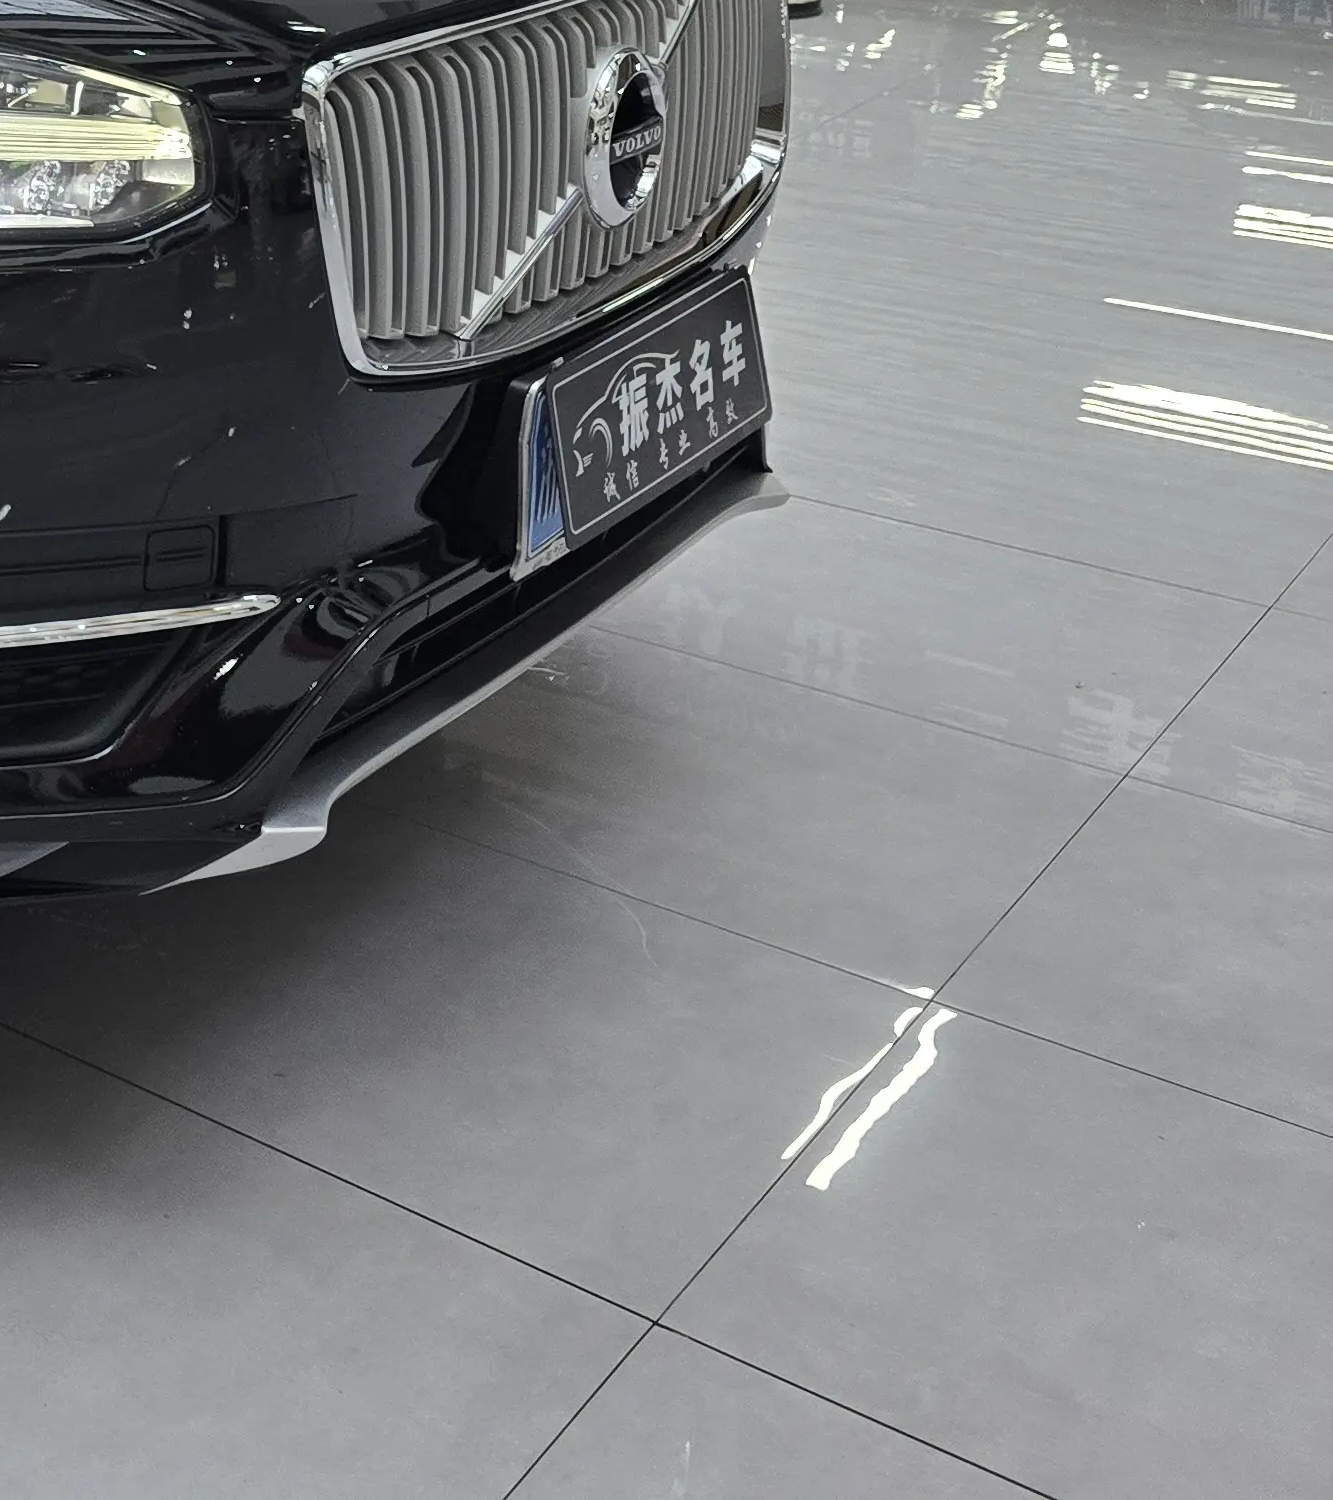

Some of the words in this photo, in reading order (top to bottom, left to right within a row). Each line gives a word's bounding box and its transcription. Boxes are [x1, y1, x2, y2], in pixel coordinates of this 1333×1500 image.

[612, 125, 661, 157] VOLVO
[615, 320, 746, 457] 振杰名车
